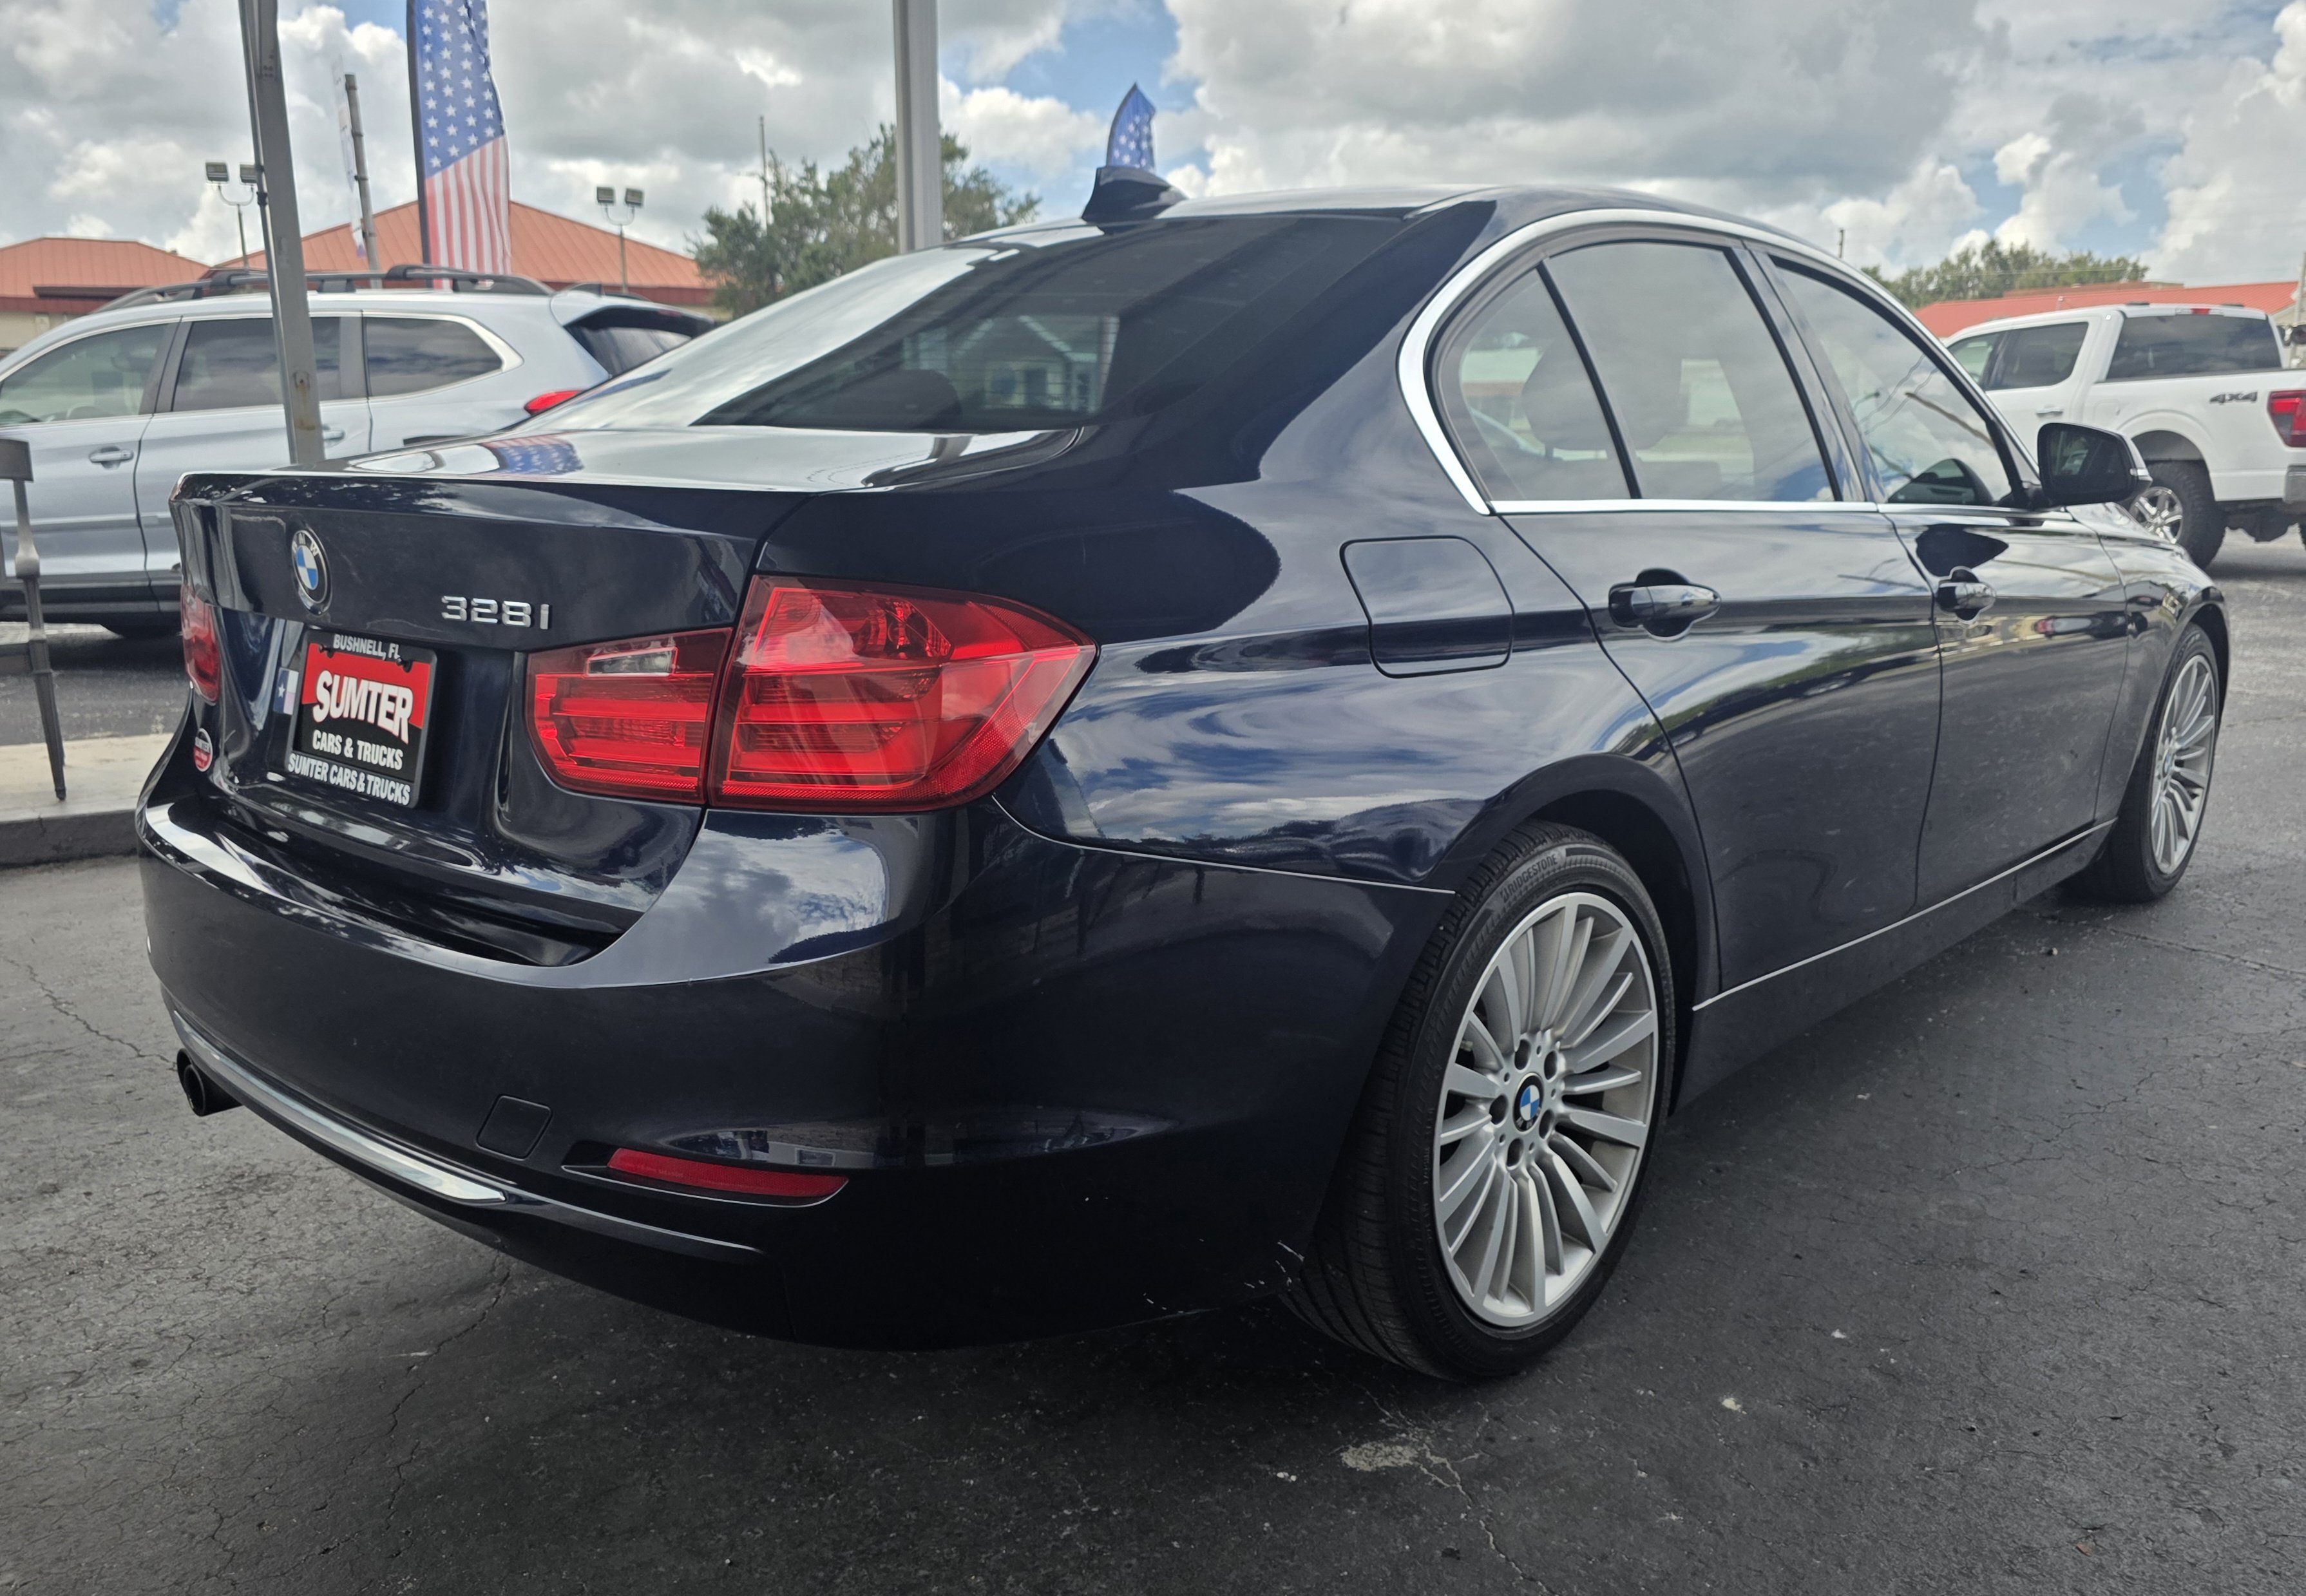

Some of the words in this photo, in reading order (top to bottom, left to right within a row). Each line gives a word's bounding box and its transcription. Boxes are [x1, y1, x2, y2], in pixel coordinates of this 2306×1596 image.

[333, 634, 386, 661] BUSHNELL,
[312, 670, 414, 745] SUMTER
[312, 729, 343, 755] CARS
[343, 737, 354, 758] &
[357, 739, 404, 770] TRUCKS
[287, 753, 329, 783] SUMTER
[329, 765, 358, 790] CARS
[356, 772, 366, 793] &
[366, 774, 411, 806] TRUCKS
[1500, 853, 1558, 903] BRIDGESTONE
